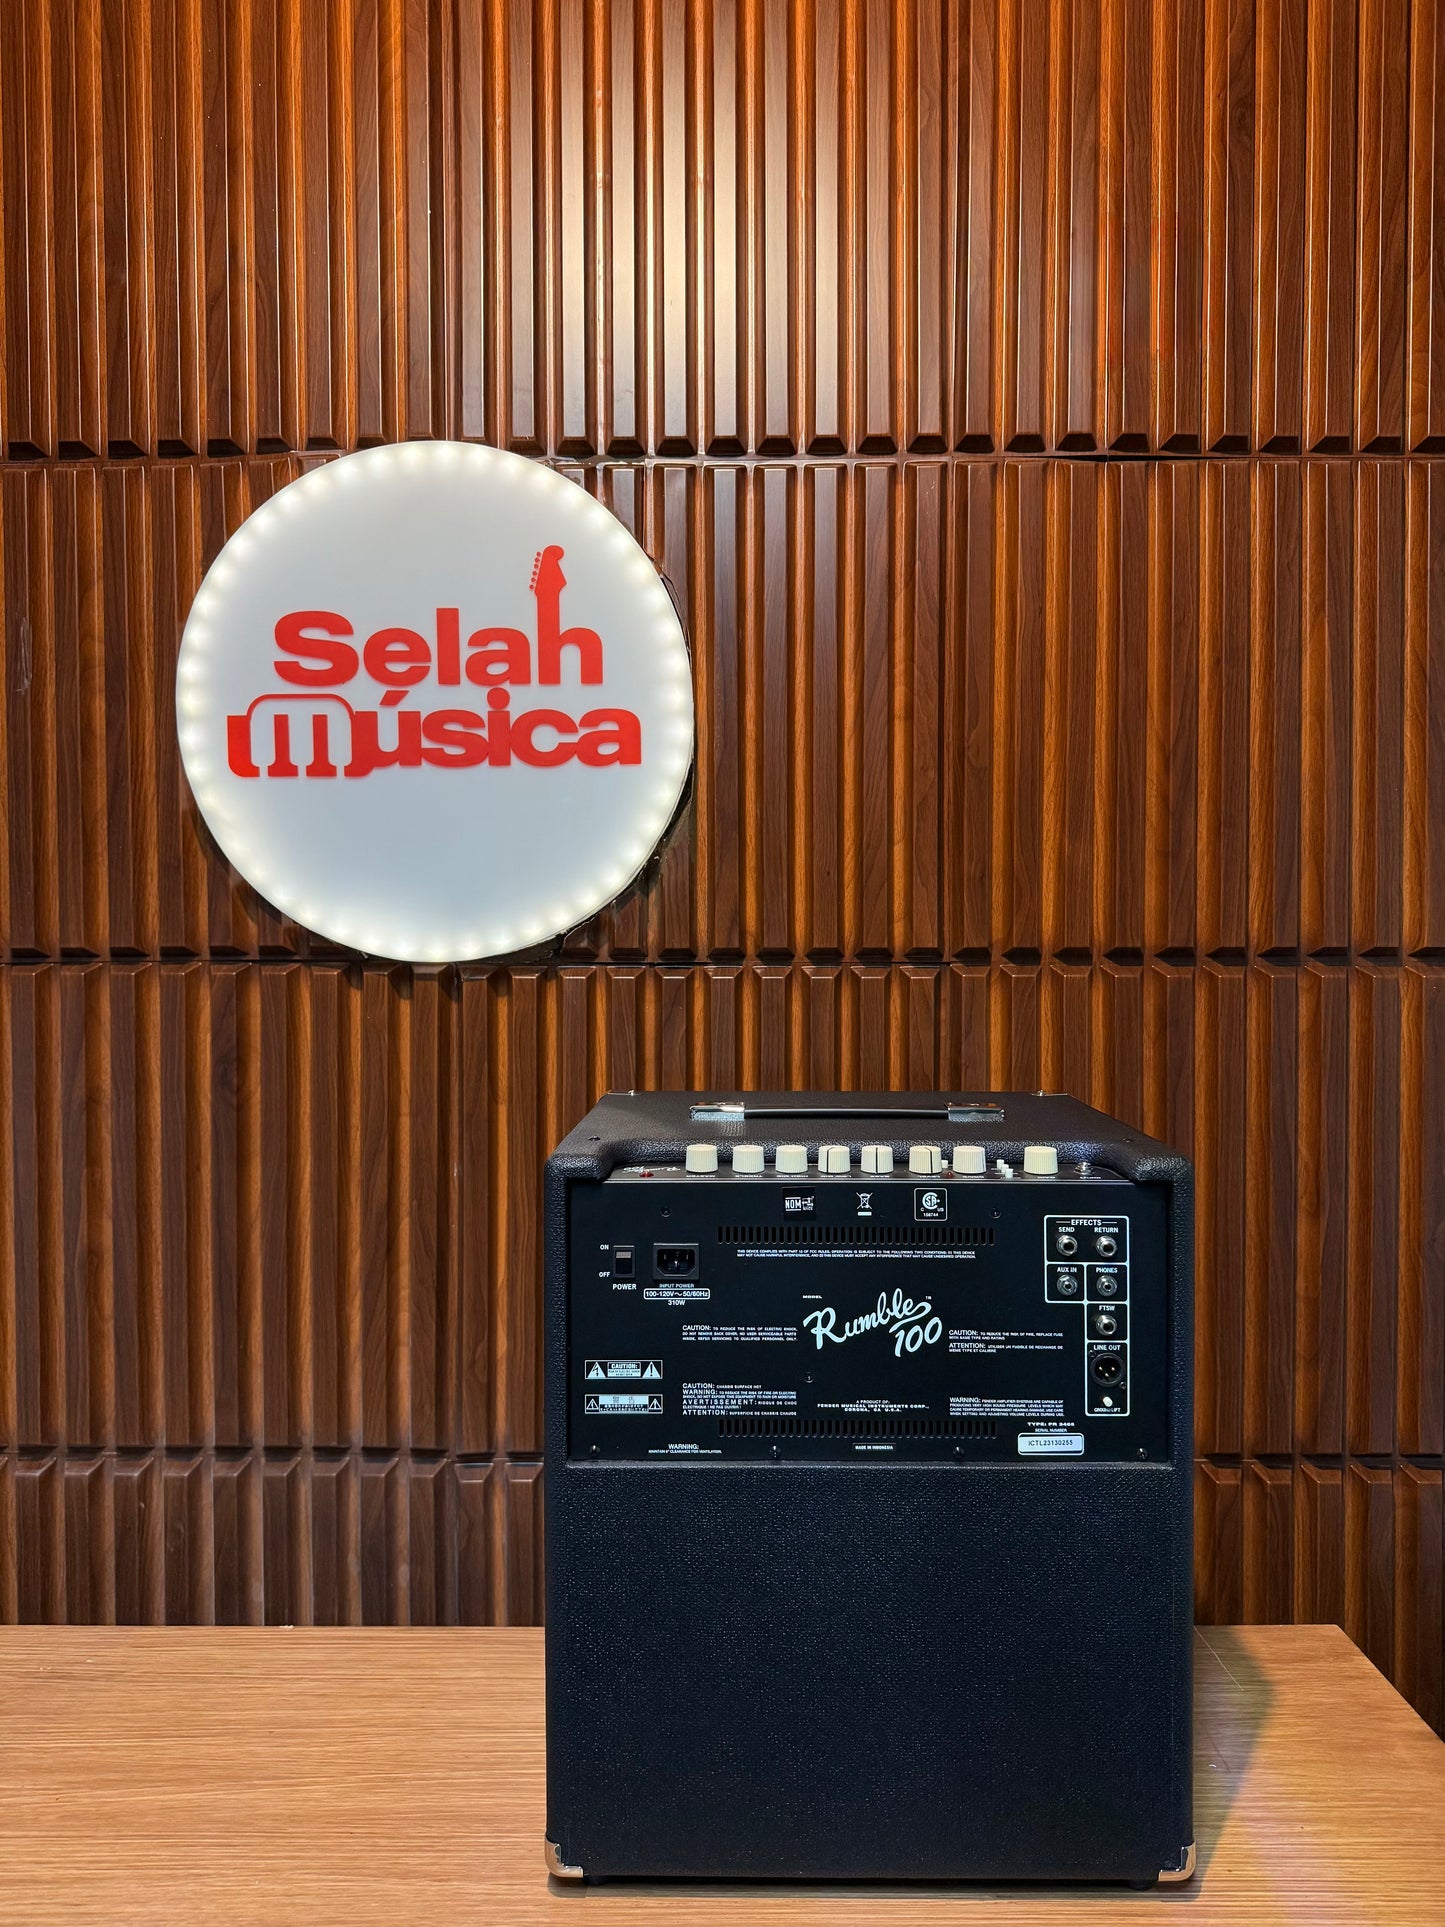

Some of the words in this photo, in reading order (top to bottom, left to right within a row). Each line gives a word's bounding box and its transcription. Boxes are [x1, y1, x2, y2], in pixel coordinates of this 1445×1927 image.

[274, 546, 604, 686] Selah
[803, 1288, 932, 1350] Rumble
[894, 1317, 943, 1358] 100
